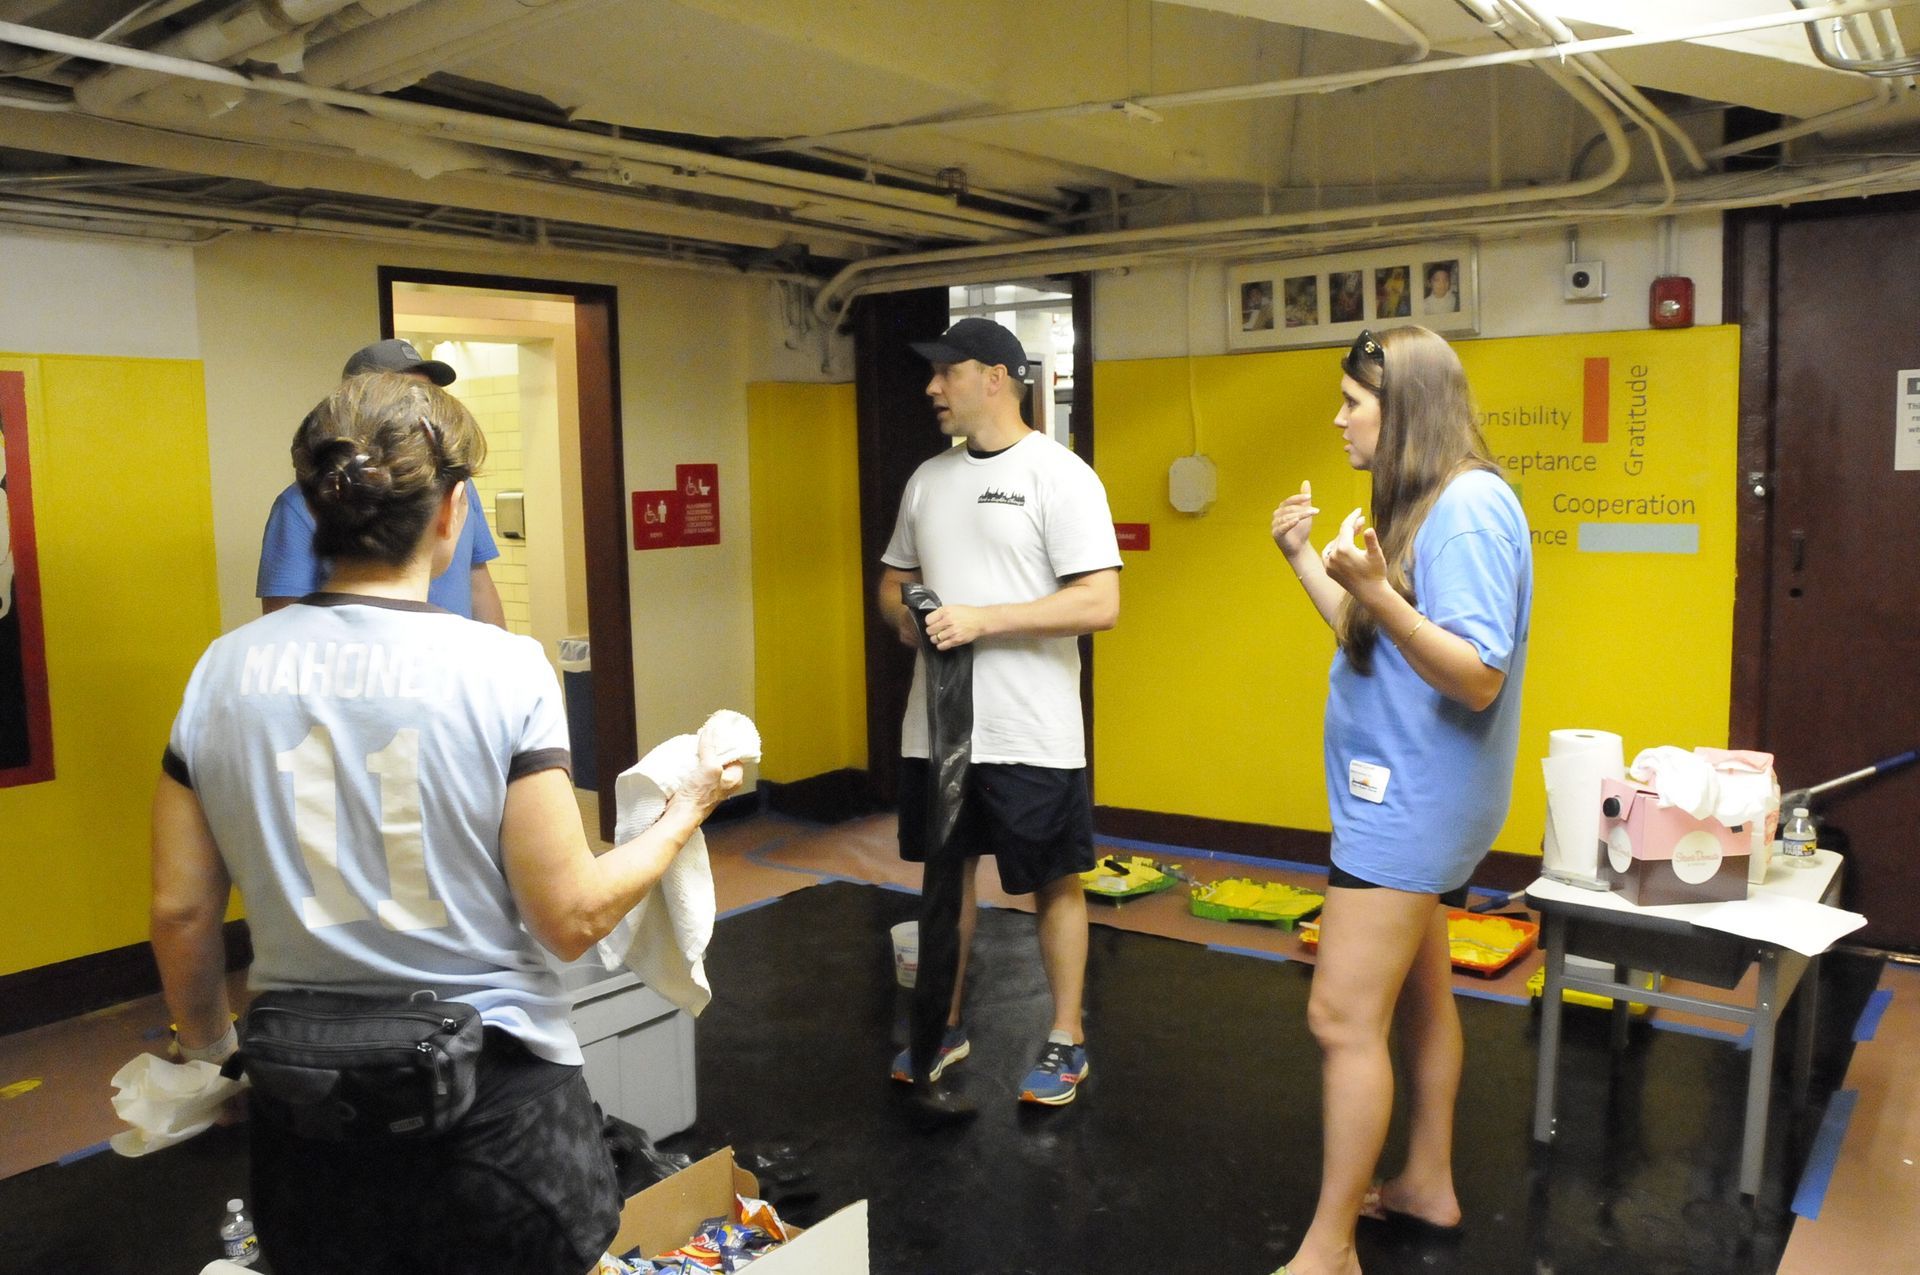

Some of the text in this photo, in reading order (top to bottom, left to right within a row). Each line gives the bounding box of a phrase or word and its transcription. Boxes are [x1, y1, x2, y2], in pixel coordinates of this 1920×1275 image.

[1478, 405, 1571, 430] onsibility
[1625, 364, 1648, 476] Gratitude
[1497, 451, 1597, 475] ceptance
[1553, 493, 1696, 518] Cooperation
[241, 641, 447, 699] MAHONE
[276, 725, 449, 932] 11
